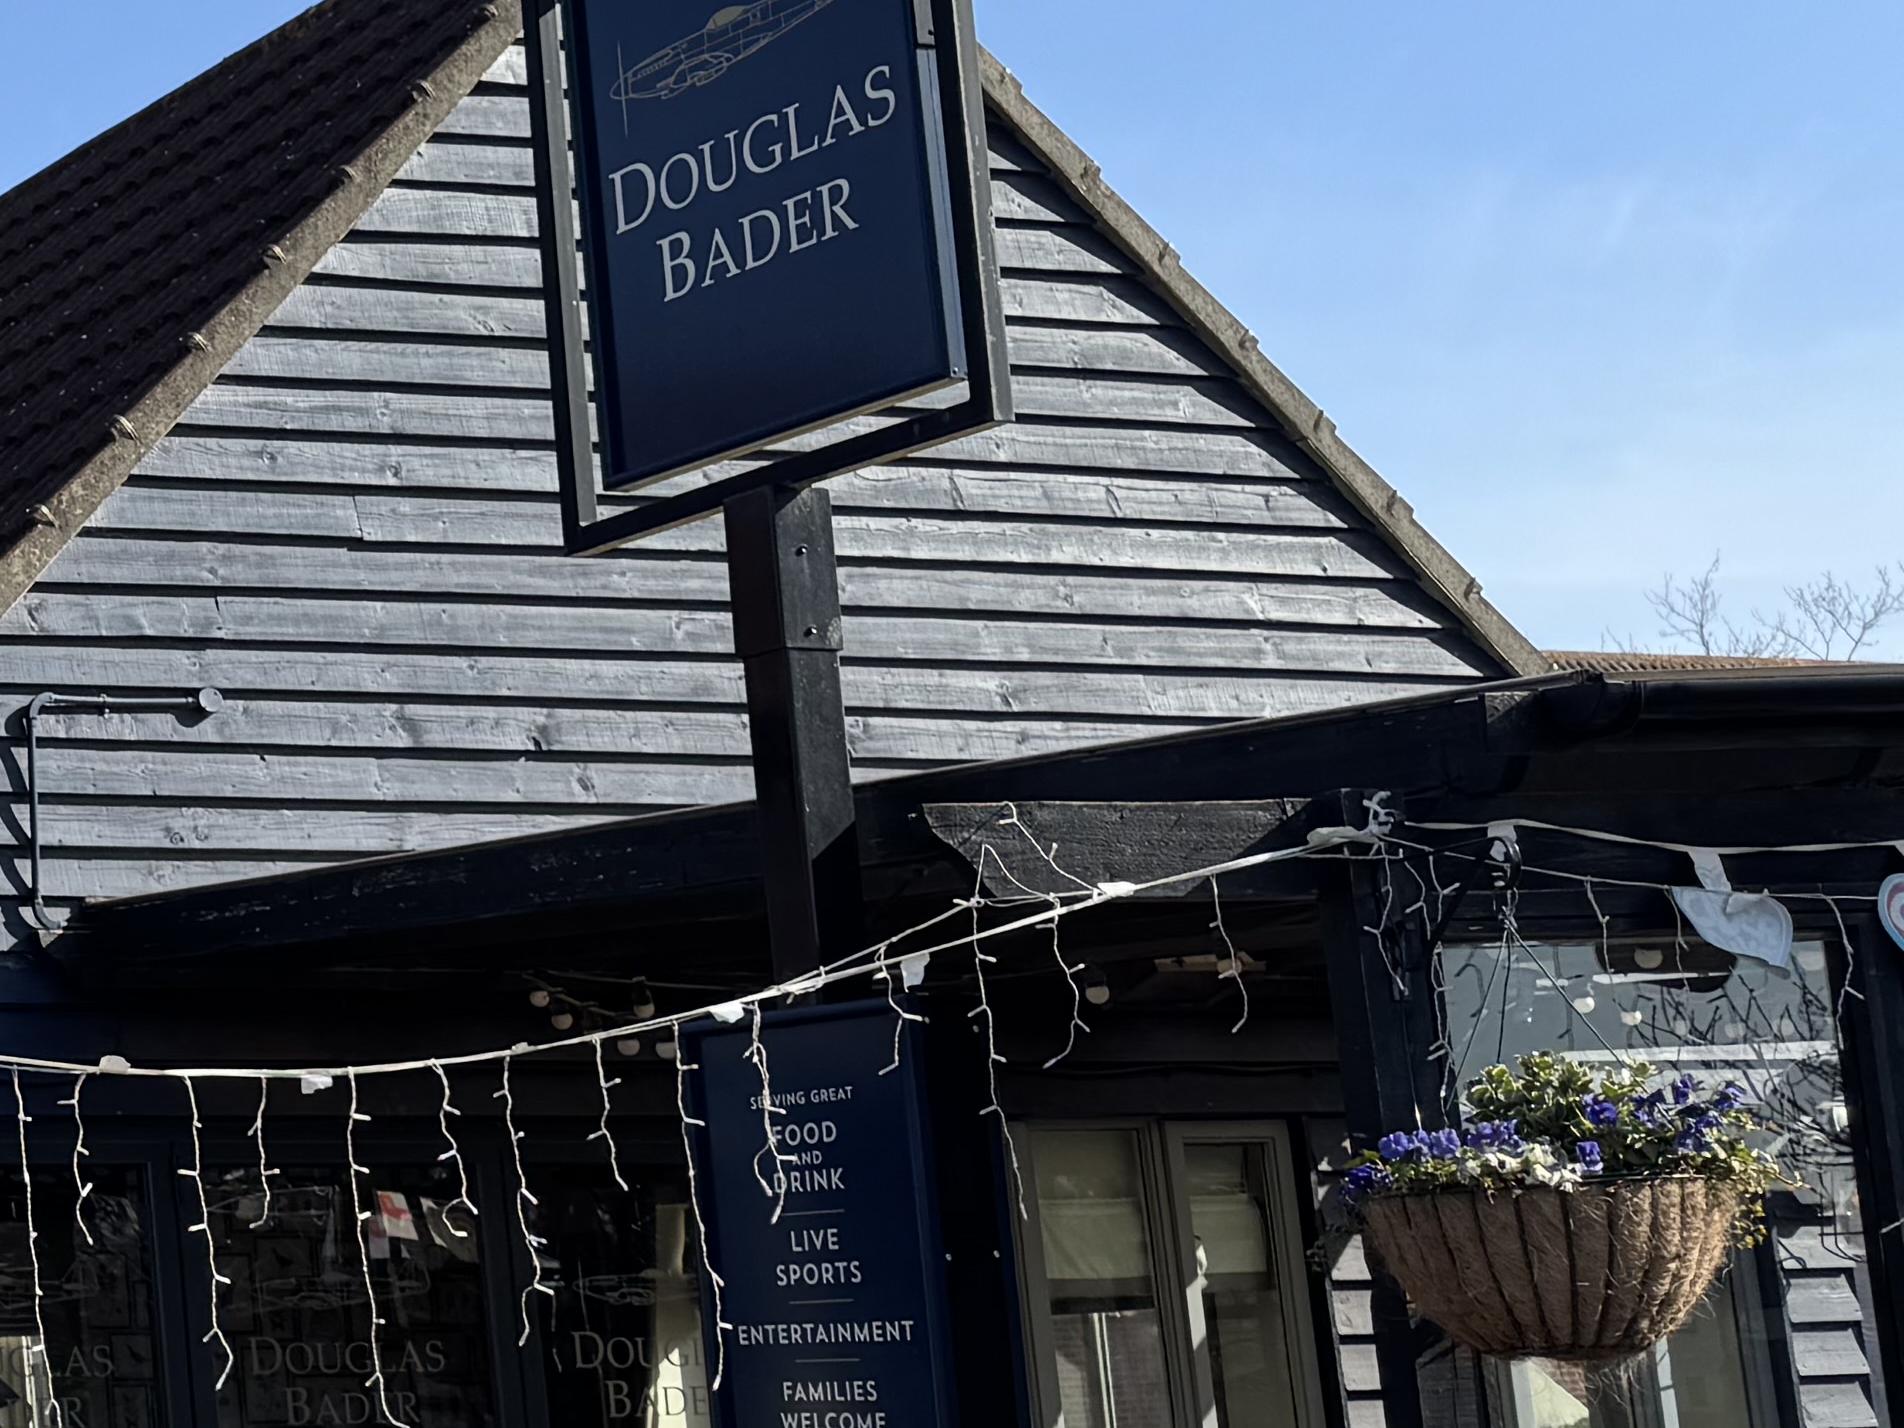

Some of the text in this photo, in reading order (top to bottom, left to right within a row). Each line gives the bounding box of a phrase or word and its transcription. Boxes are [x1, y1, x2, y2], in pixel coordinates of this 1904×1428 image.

[608, 64, 898, 236] DOUGLAS
[655, 176, 861, 304] BADER
[750, 1086, 854, 1111] SEVING GREAT
[771, 1121, 838, 1147] FOOD
[793, 1150, 823, 1166] AND
[773, 1168, 846, 1194] DRINK
[790, 1228, 840, 1253] LIVE
[776, 1261, 863, 1287] SPORTS
[738, 1320, 915, 1346] ENTERTAINMENT
[604, 1379, 709, 1419] BADE
[782, 1380, 878, 1403] FAMILIES
